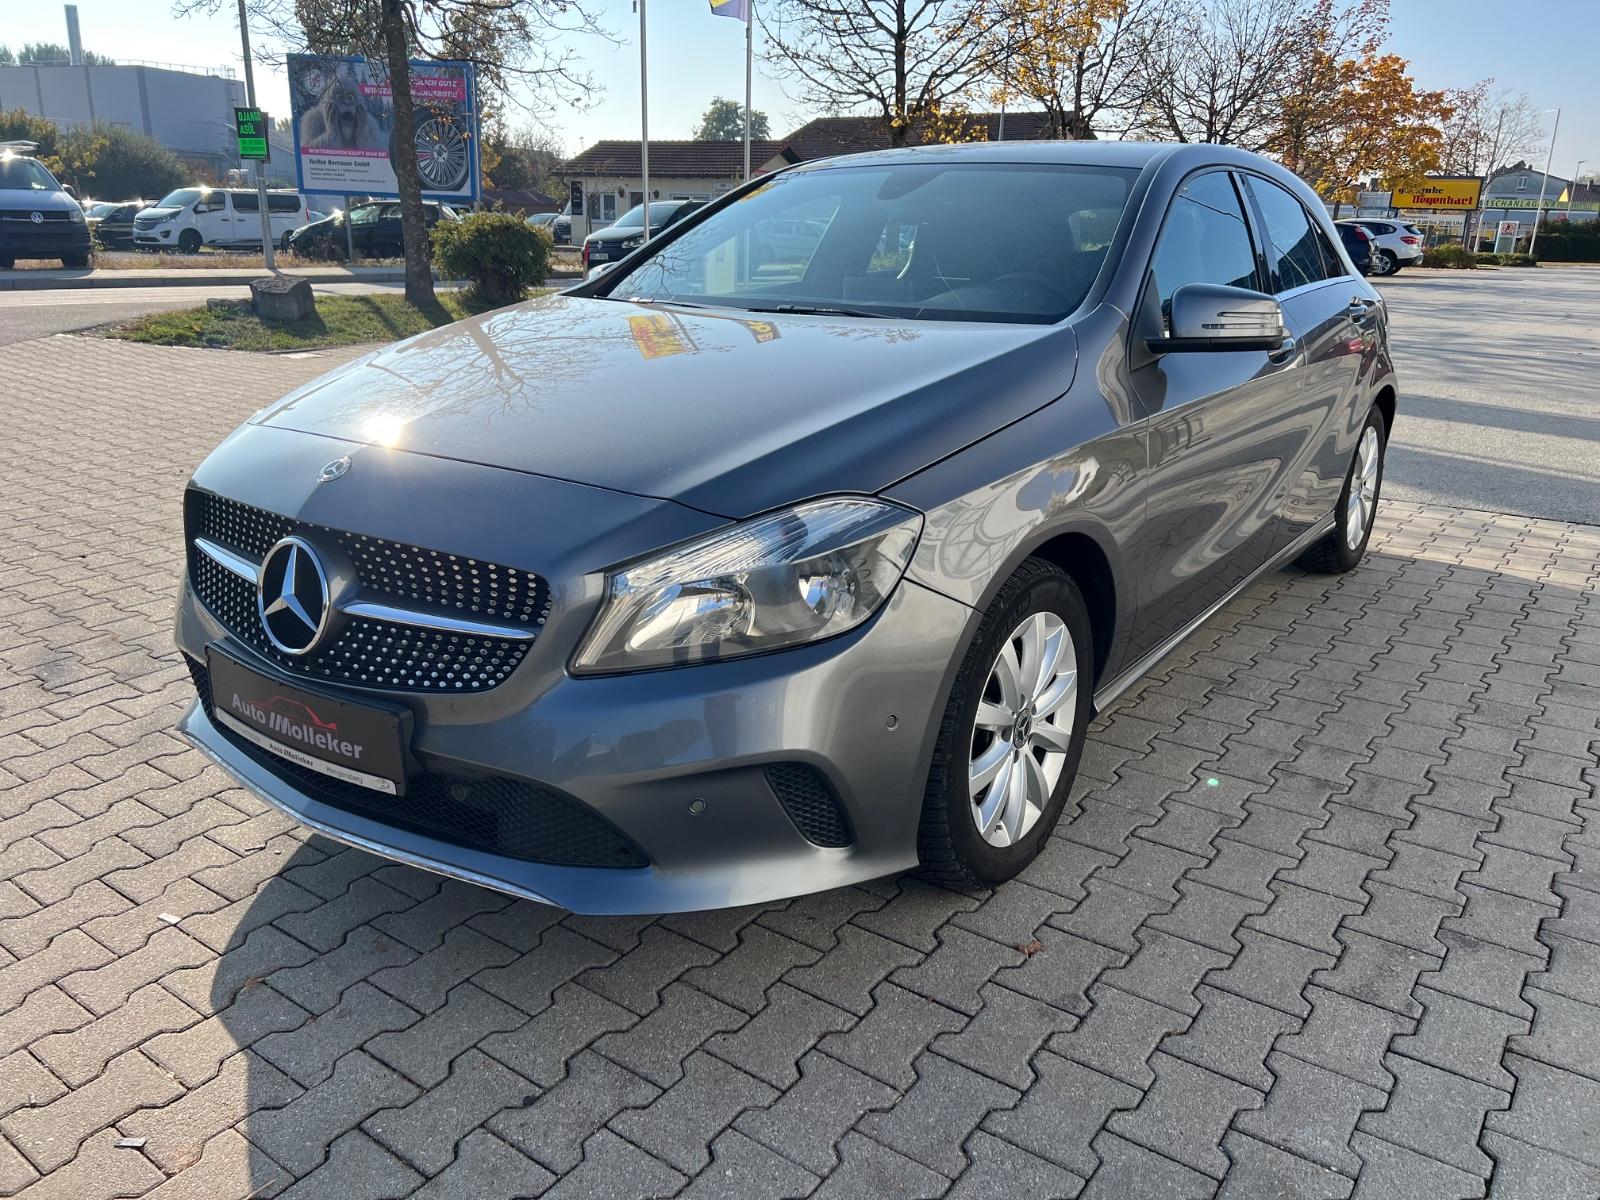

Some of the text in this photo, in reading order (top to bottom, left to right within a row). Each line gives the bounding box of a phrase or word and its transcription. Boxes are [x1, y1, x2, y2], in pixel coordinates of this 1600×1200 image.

[309, 158, 327, 166] Reifen
[353, 160, 370, 168] GmbH
[231, 692, 267, 725] Auto
[269, 711, 363, 759] Molleker
[269, 743, 283, 754] Auto
